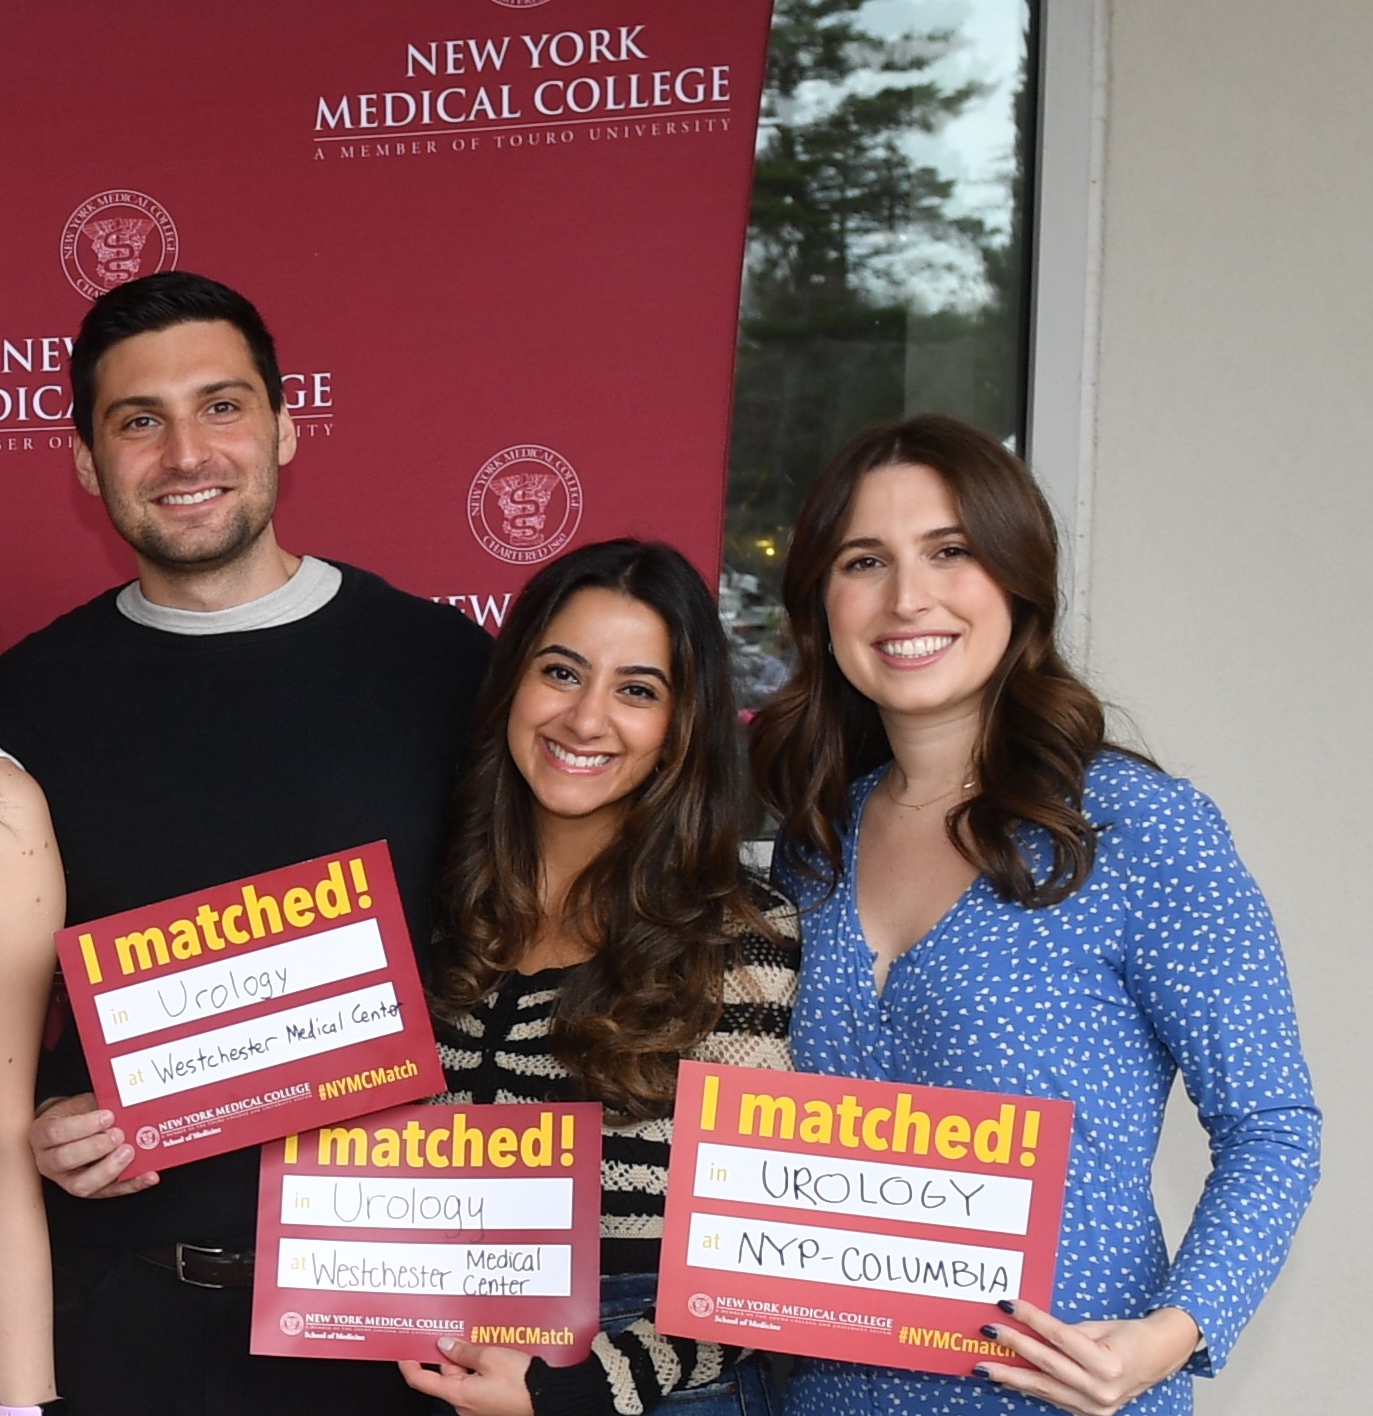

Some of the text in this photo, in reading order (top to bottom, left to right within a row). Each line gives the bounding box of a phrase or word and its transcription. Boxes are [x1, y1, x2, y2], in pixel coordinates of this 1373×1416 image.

[407, 25, 648, 77] NEW YORK
[315, 66, 730, 130] MEDICAL COLLEGE
[314, 119, 730, 160] A MEMBER OF TOURO UNIVERSITY
[79, 859, 372, 984] I matched!
[157, 967, 289, 1019] Urology
[151, 1034, 278, 1085] Westchester
[286, 1012, 344, 1044] Medical
[318, 1061, 418, 1099] #NYMCMatch
[158, 1118, 183, 1132] NEW
[184, 1108, 214, 1125] YORK
[216, 1095, 262, 1116] MEDICAL
[263, 1083, 310, 1103] COLLEGE
[701, 1076, 1040, 1166] I matched!
[319, 1112, 575, 1168] matched!
[334, 1182, 485, 1243] Urology
[762, 1160, 985, 1217] UROLOGY
[312, 1249, 452, 1291] Westchester
[466, 1247, 541, 1272] Medical
[462, 1275, 531, 1297] Center
[737, 1231, 1009, 1295] NYP-COLUMBIA
[305, 1314, 464, 1330] NEW YORK MEDICAL COLLEGE
[471, 1326, 574, 1345] #NYMCMatch
[716, 1296, 743, 1308] NEW
[744, 1299, 779, 1314] YORK
[781, 1305, 836, 1321] MEDICAL
[839, 1312, 893, 1329] COLLEGE
